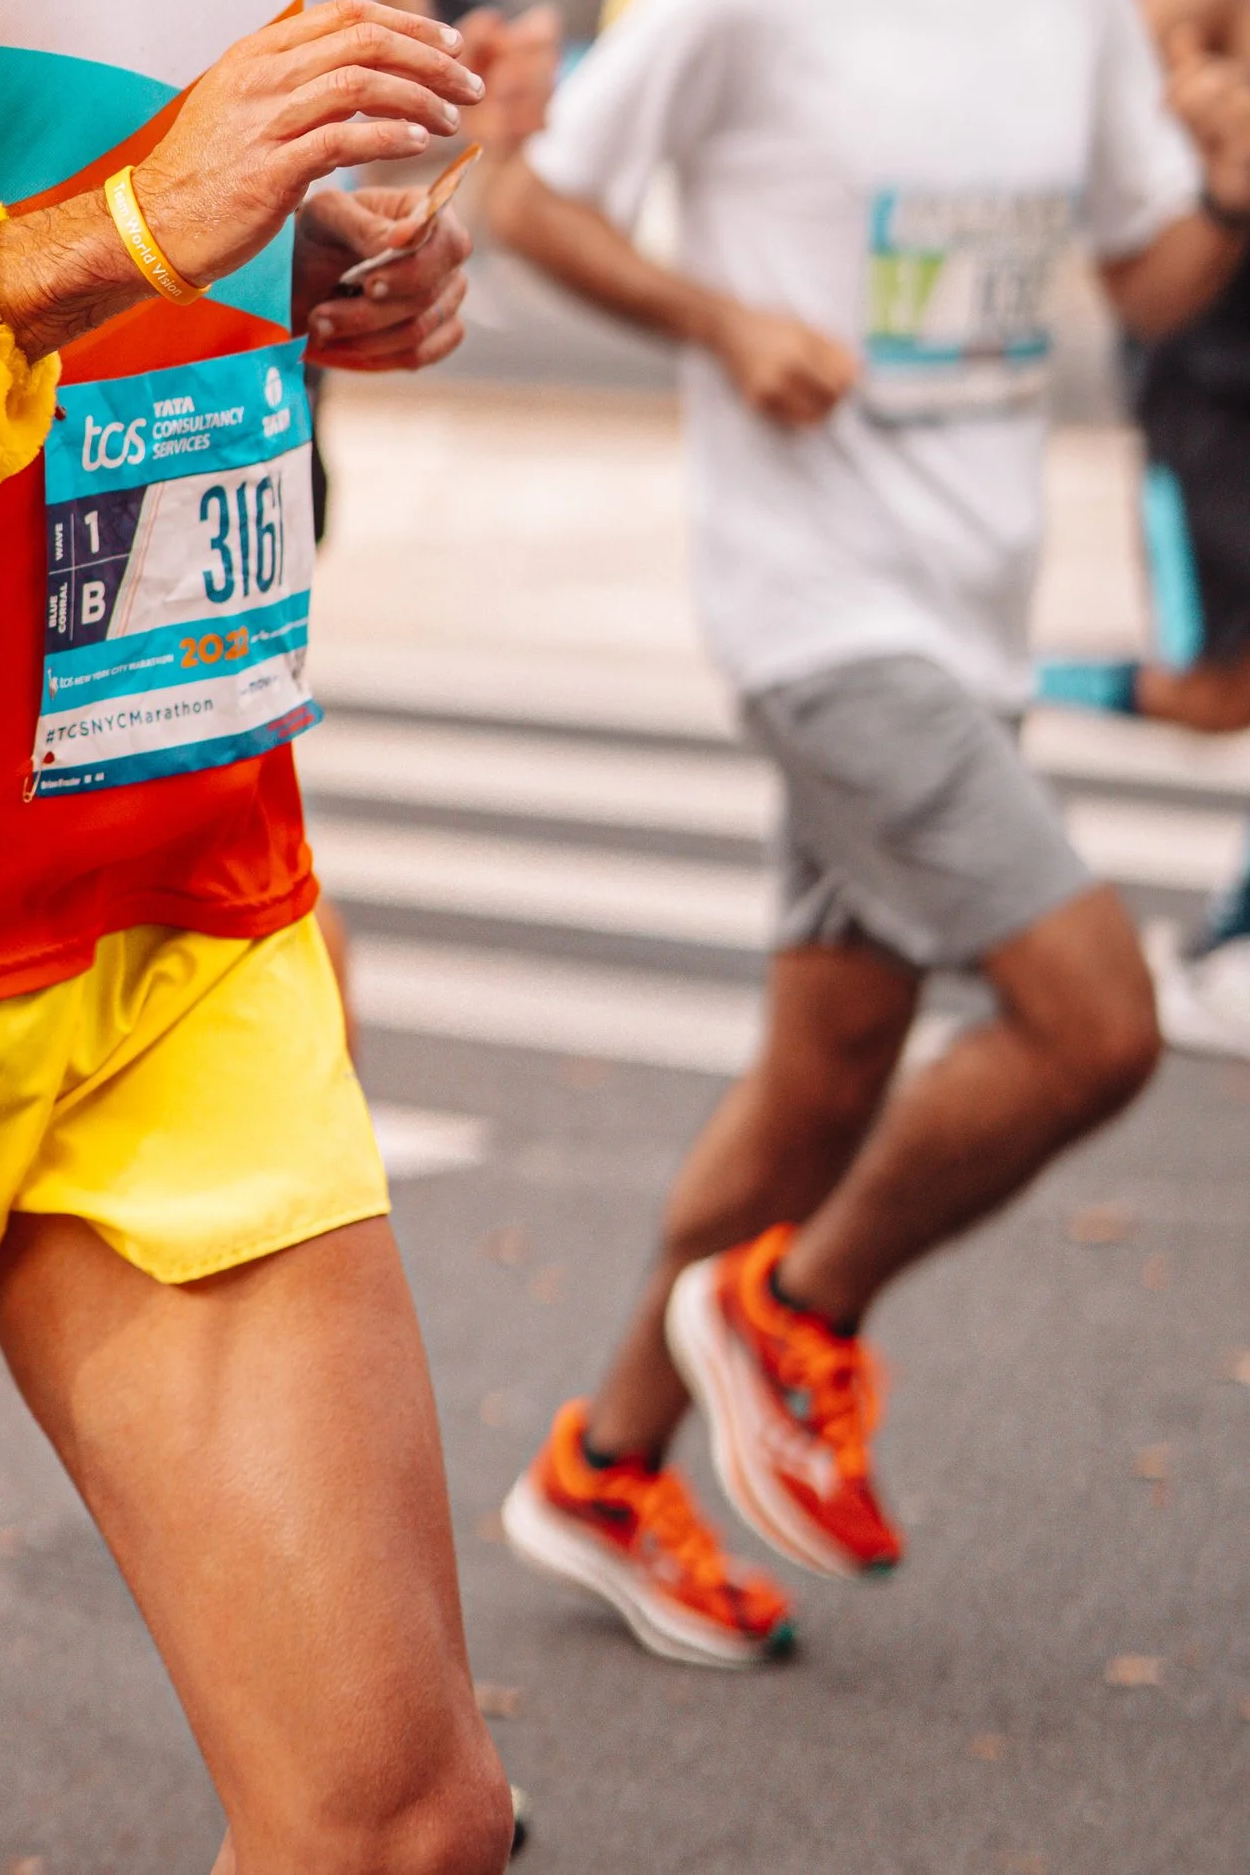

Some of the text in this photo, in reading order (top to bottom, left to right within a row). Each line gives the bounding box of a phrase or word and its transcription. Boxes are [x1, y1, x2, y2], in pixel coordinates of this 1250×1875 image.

[113, 182, 183, 297] Team World Vision
[152, 406, 245, 440] CONSULTANCY
[153, 396, 195, 418] TATA
[82, 414, 147, 472] tcs
[152, 434, 211, 459] SERVICES
[55, 523, 63, 561] WAVE
[84, 510, 100, 554] 1
[49, 595, 58, 628] BLUE
[58, 582, 68, 634] CORRAL
[81, 581, 106, 625] B
[110, 664, 128, 676] CITY
[46, 699, 214, 744] #TCSNYCMarathon
